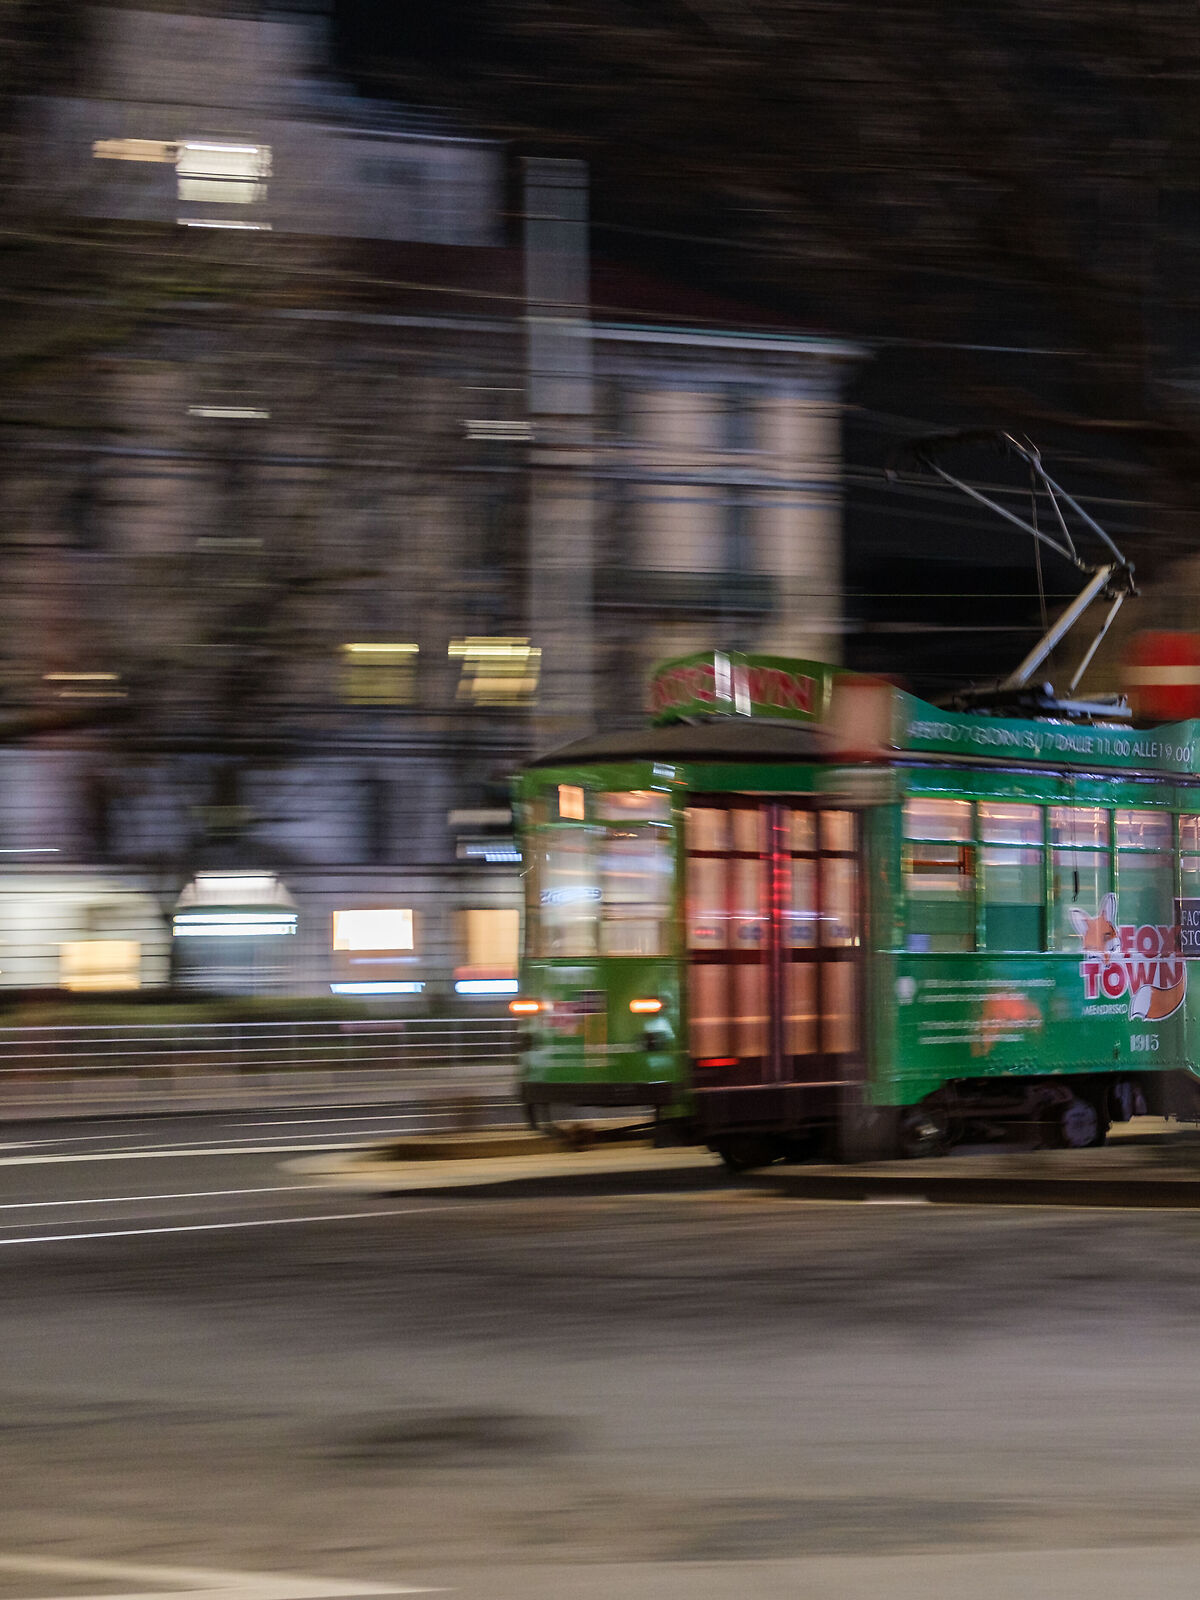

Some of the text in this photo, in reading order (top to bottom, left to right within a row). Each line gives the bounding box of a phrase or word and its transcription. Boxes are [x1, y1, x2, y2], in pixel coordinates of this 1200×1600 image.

[1055, 733, 1094, 754] DALLE
[1096, 737, 1131, 757] 11.00
[1132, 740, 1158, 758] ALLE
[1159, 743, 1190, 762] 19.00
[1118, 925, 1185, 959] FOX
[1080, 960, 1186, 999] TOWN
